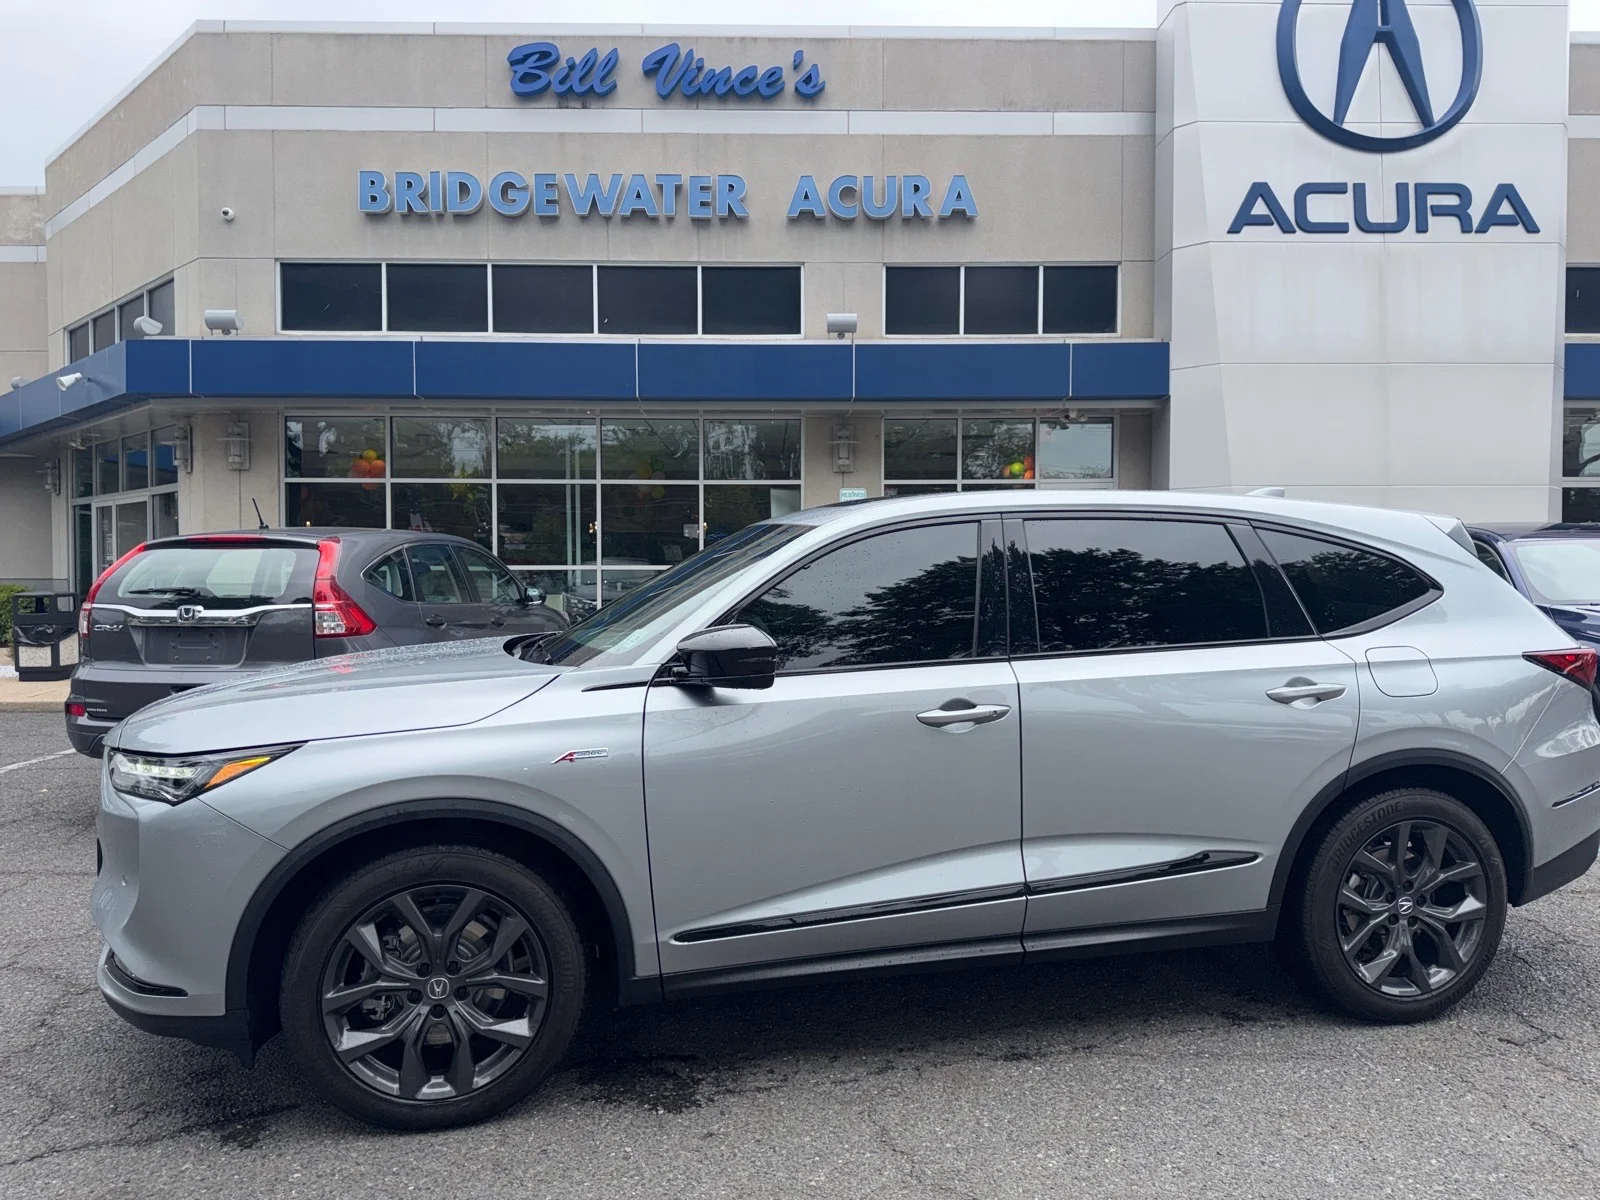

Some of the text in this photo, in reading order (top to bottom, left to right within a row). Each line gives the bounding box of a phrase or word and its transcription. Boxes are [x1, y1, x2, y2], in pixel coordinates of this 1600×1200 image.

[507, 42, 826, 99] Bill Vince's
[357, 170, 980, 221] BRIDGEWATER ACURA
[1227, 181, 1541, 234] ACURA
